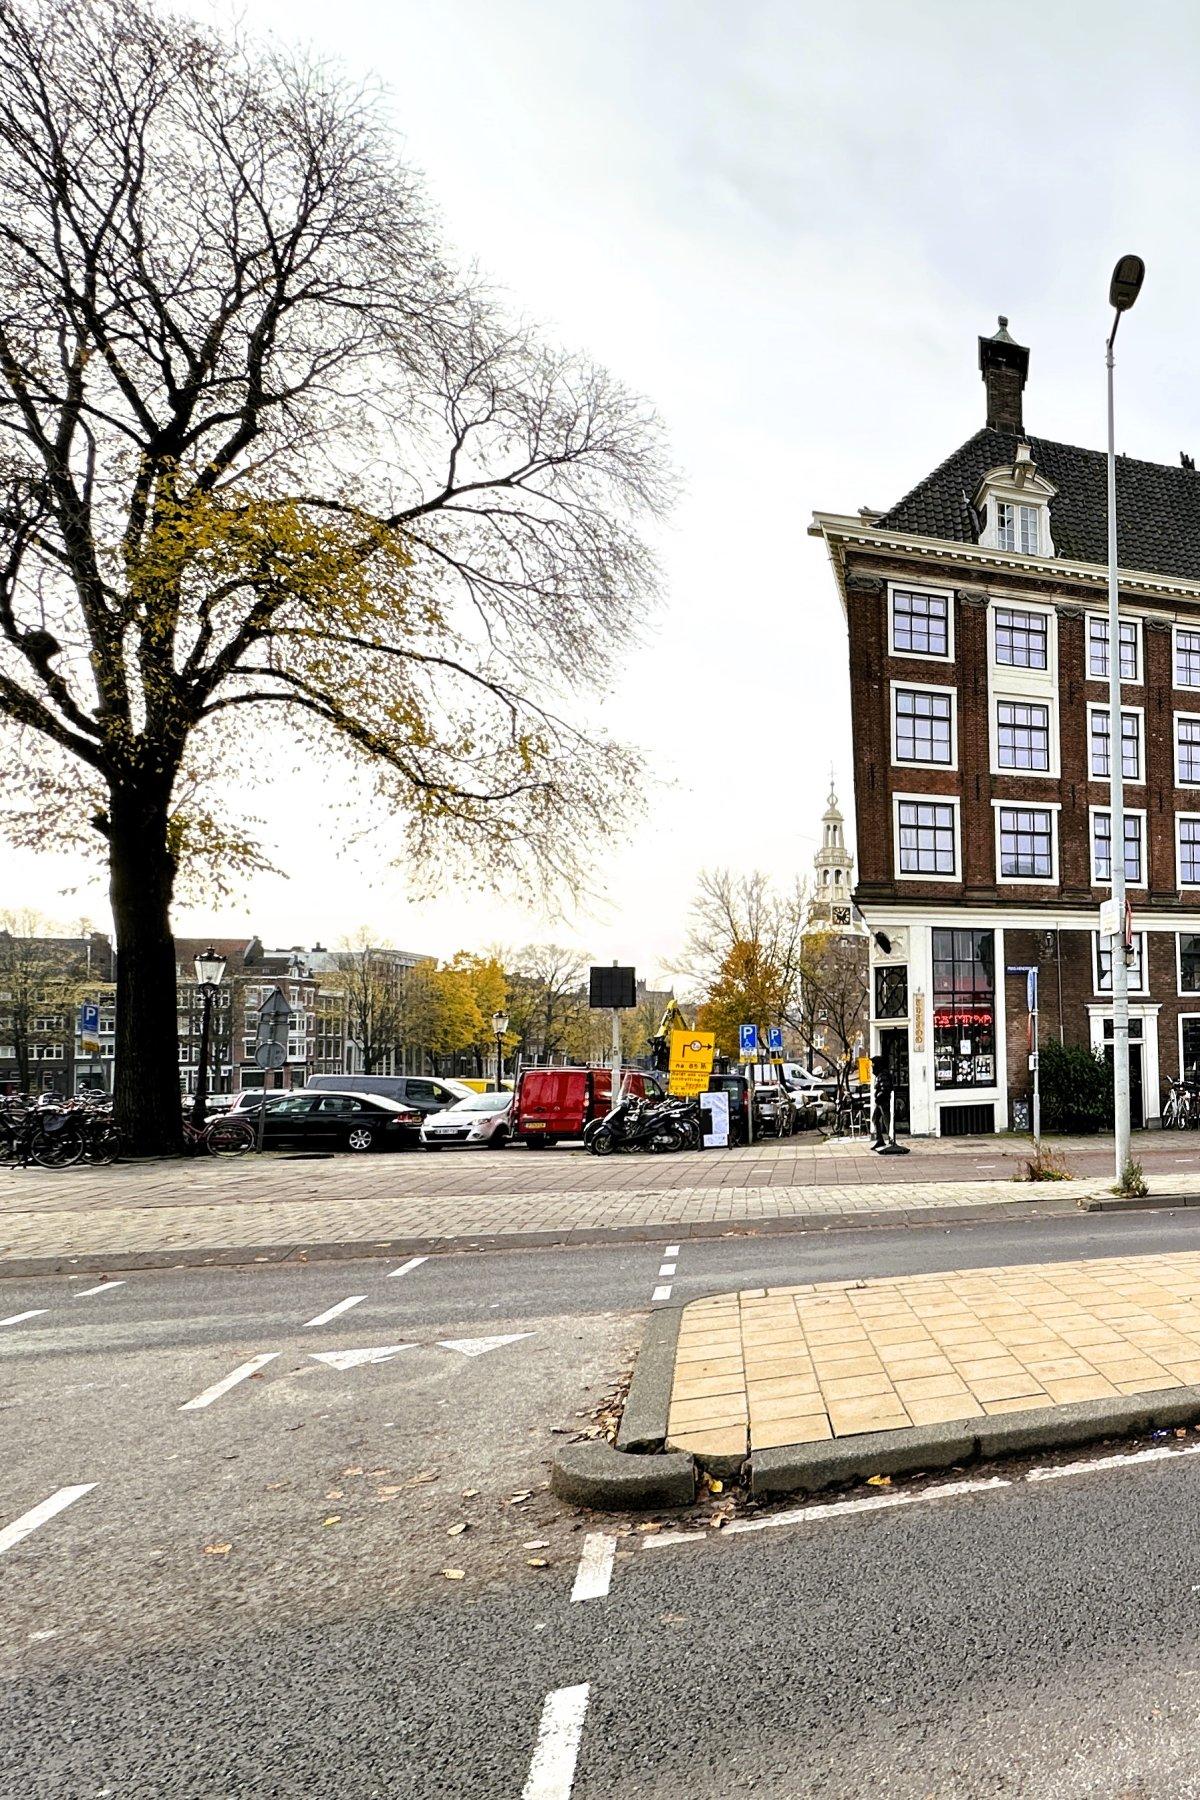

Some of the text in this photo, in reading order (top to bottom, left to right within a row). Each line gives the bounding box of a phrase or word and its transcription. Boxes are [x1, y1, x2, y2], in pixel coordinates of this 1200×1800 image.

[86, 1006, 96, 1020] P
[743, 1026, 753, 1039] P
[771, 1030, 779, 1040] P
